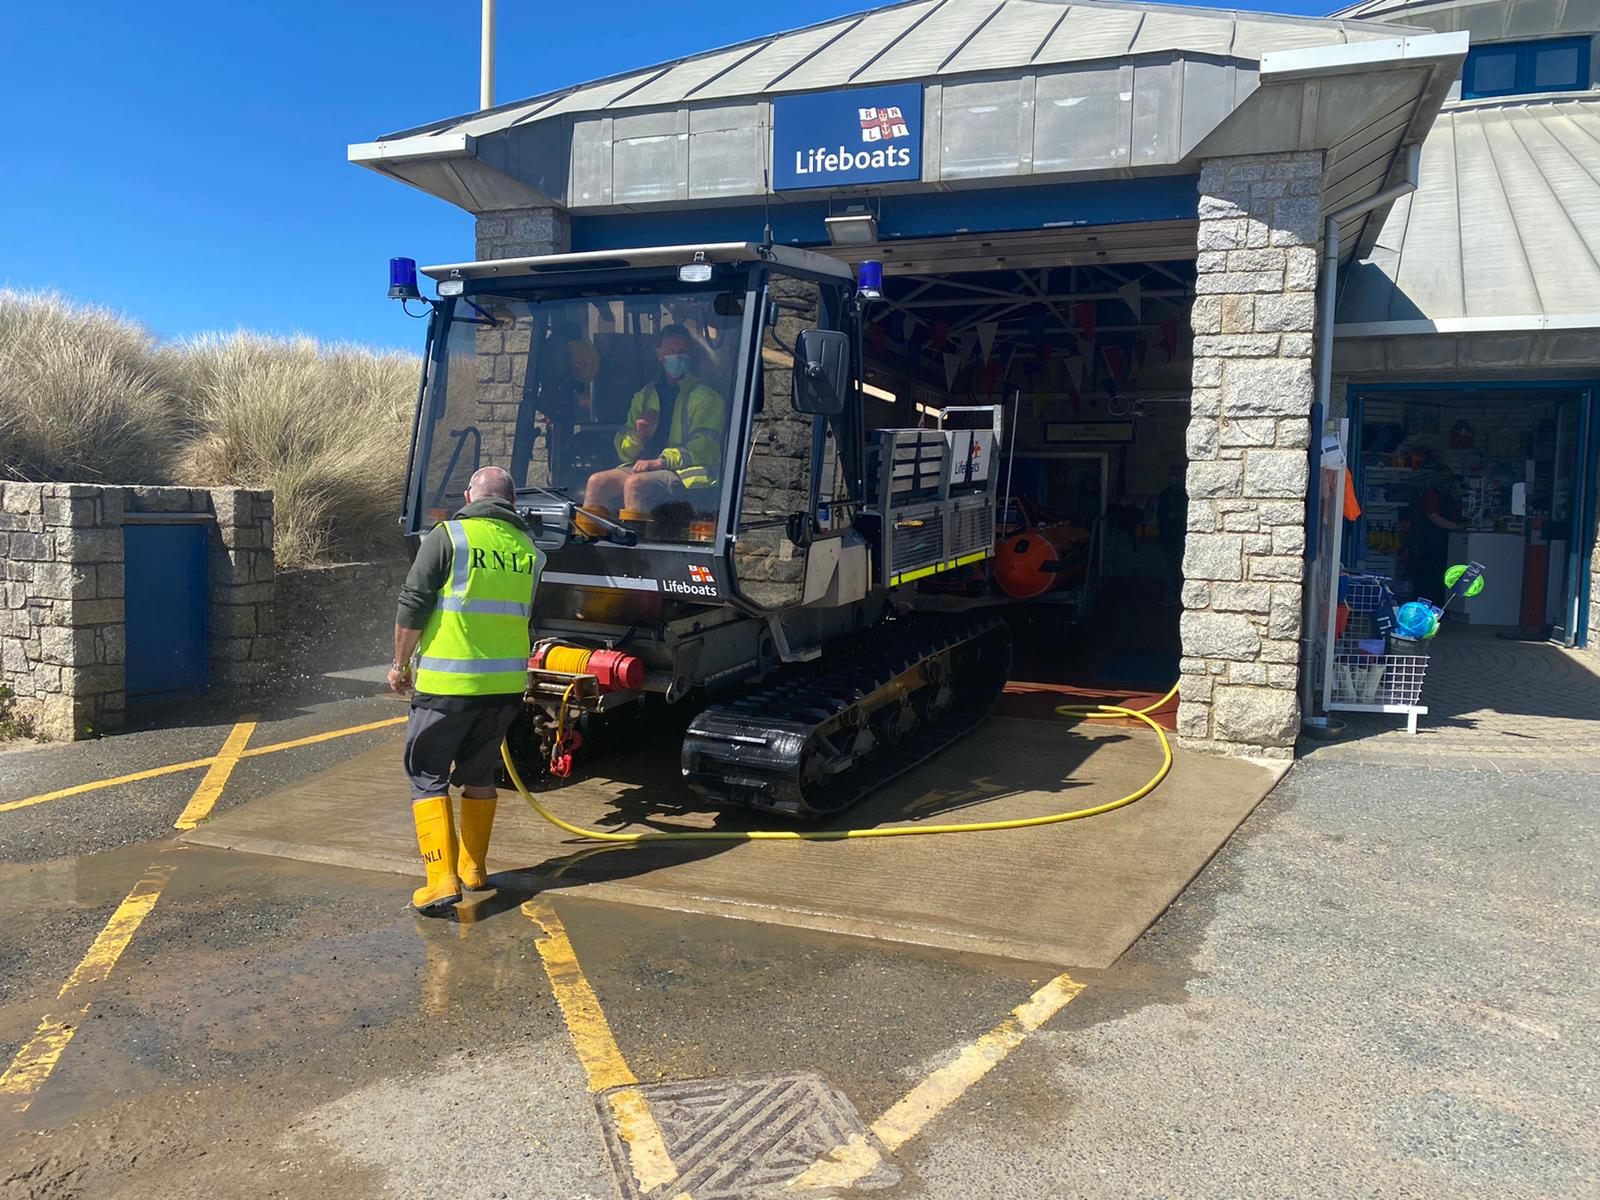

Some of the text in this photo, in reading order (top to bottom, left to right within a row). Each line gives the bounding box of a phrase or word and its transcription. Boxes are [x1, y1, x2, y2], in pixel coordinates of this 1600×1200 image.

[796, 144, 910, 174] Lifeboats
[472, 547, 534, 575] RNLI
[662, 580, 717, 596] Lifeboats
[422, 848, 442, 865] NLI
